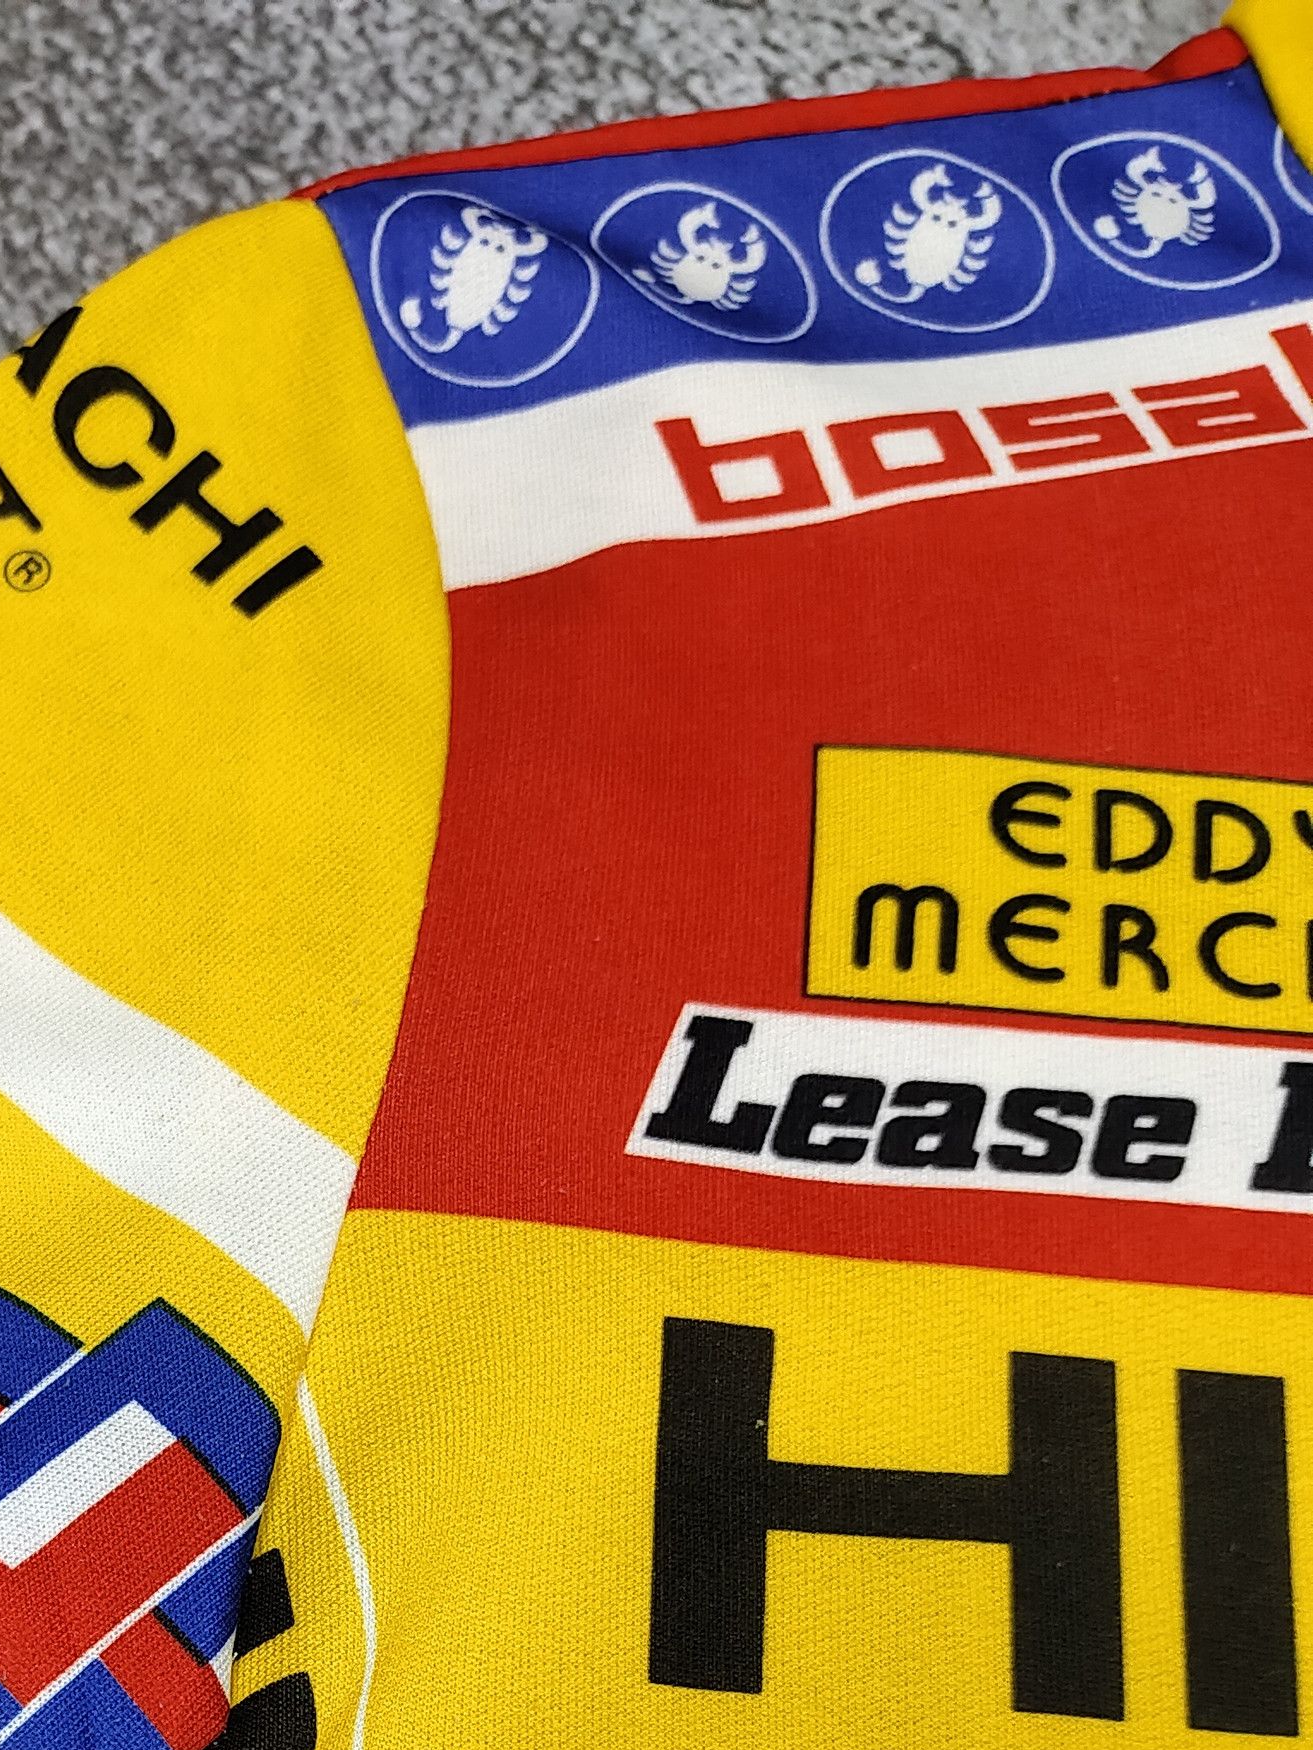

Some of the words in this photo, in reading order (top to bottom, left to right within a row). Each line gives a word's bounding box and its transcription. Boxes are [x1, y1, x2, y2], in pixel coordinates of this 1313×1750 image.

[852, 883, 1313, 1002] MERC
[645, 1015, 1197, 1183] Lease
[648, 1315, 1300, 1737] HI
